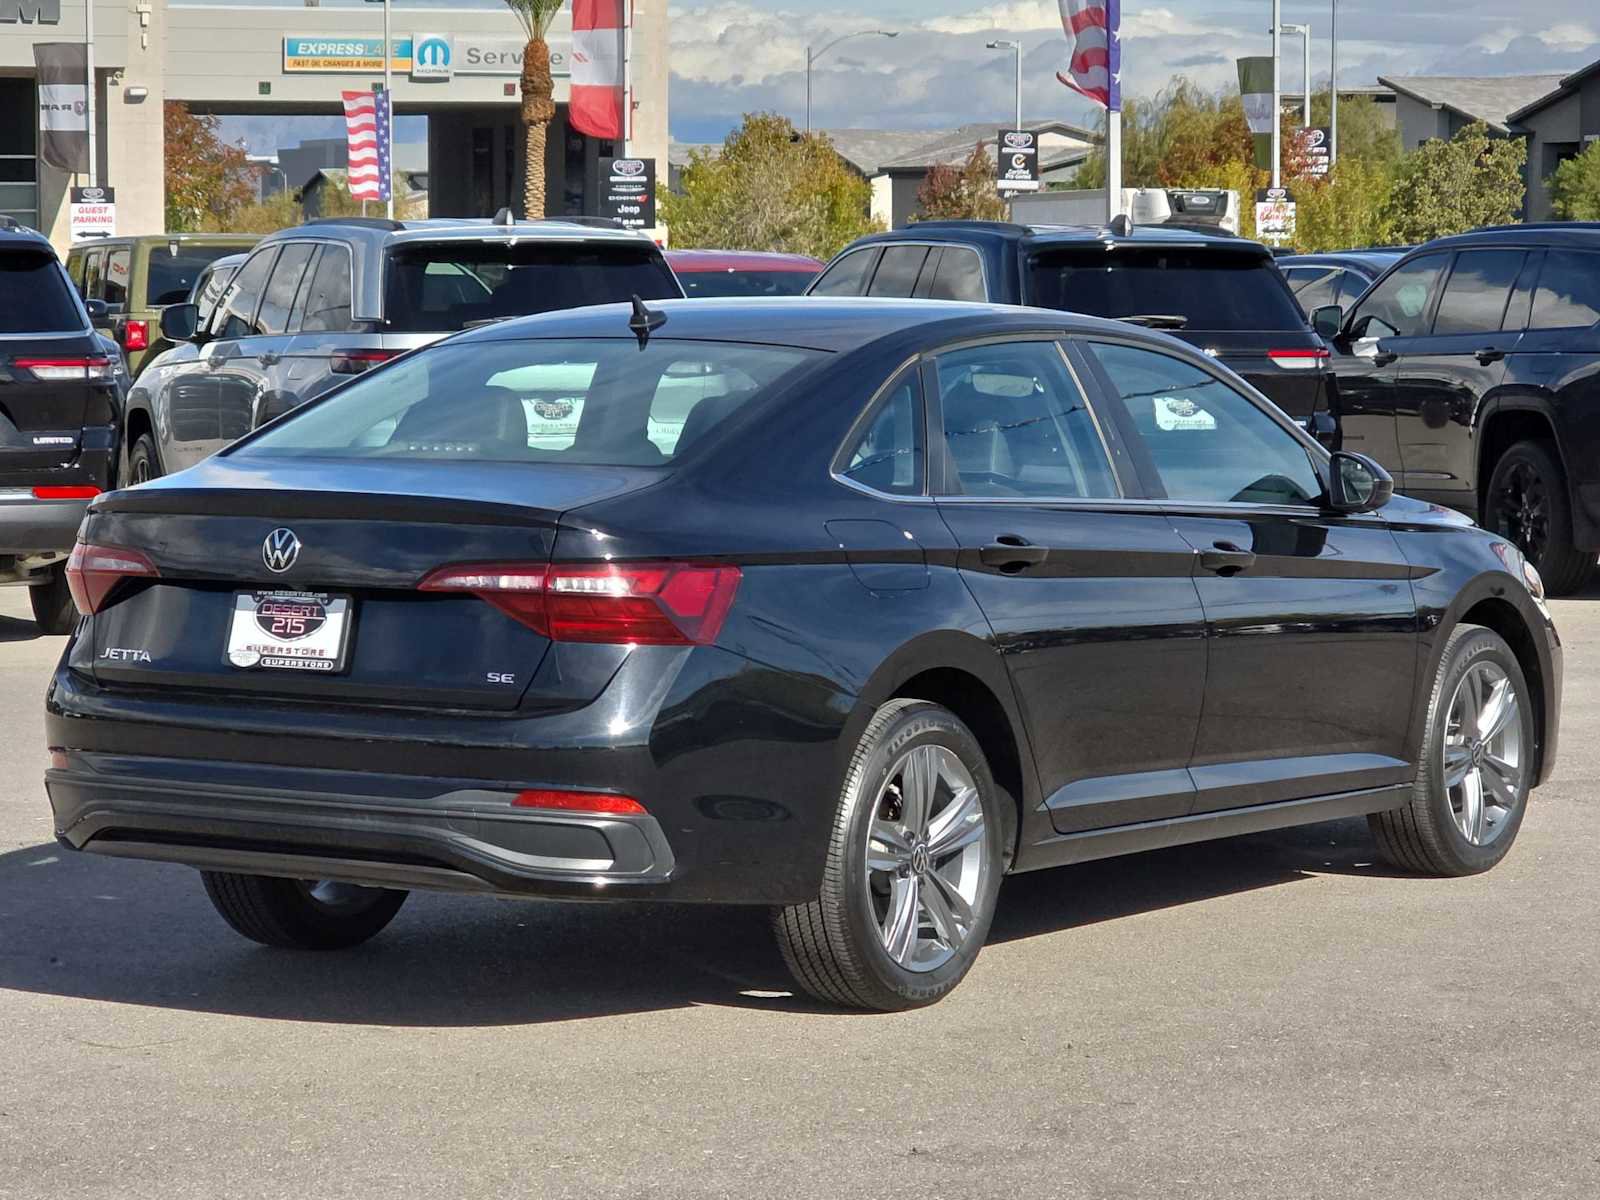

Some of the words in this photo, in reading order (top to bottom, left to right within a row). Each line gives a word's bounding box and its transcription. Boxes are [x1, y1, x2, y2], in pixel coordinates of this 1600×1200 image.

[297, 42, 364, 56] EXPRESS
[466, 47, 564, 65] Serve
[78, 206, 108, 214] GUEST
[617, 204, 640, 215] Jeep
[72, 215, 113, 224] PARKING
[261, 603, 322, 617] DESERT
[271, 617, 305, 634] 215
[100, 647, 152, 662] JETTA
[245, 644, 326, 657] SUPERSTORE
[265, 658, 330, 668] SUPERSTORE
[486, 672, 516, 684] SE
